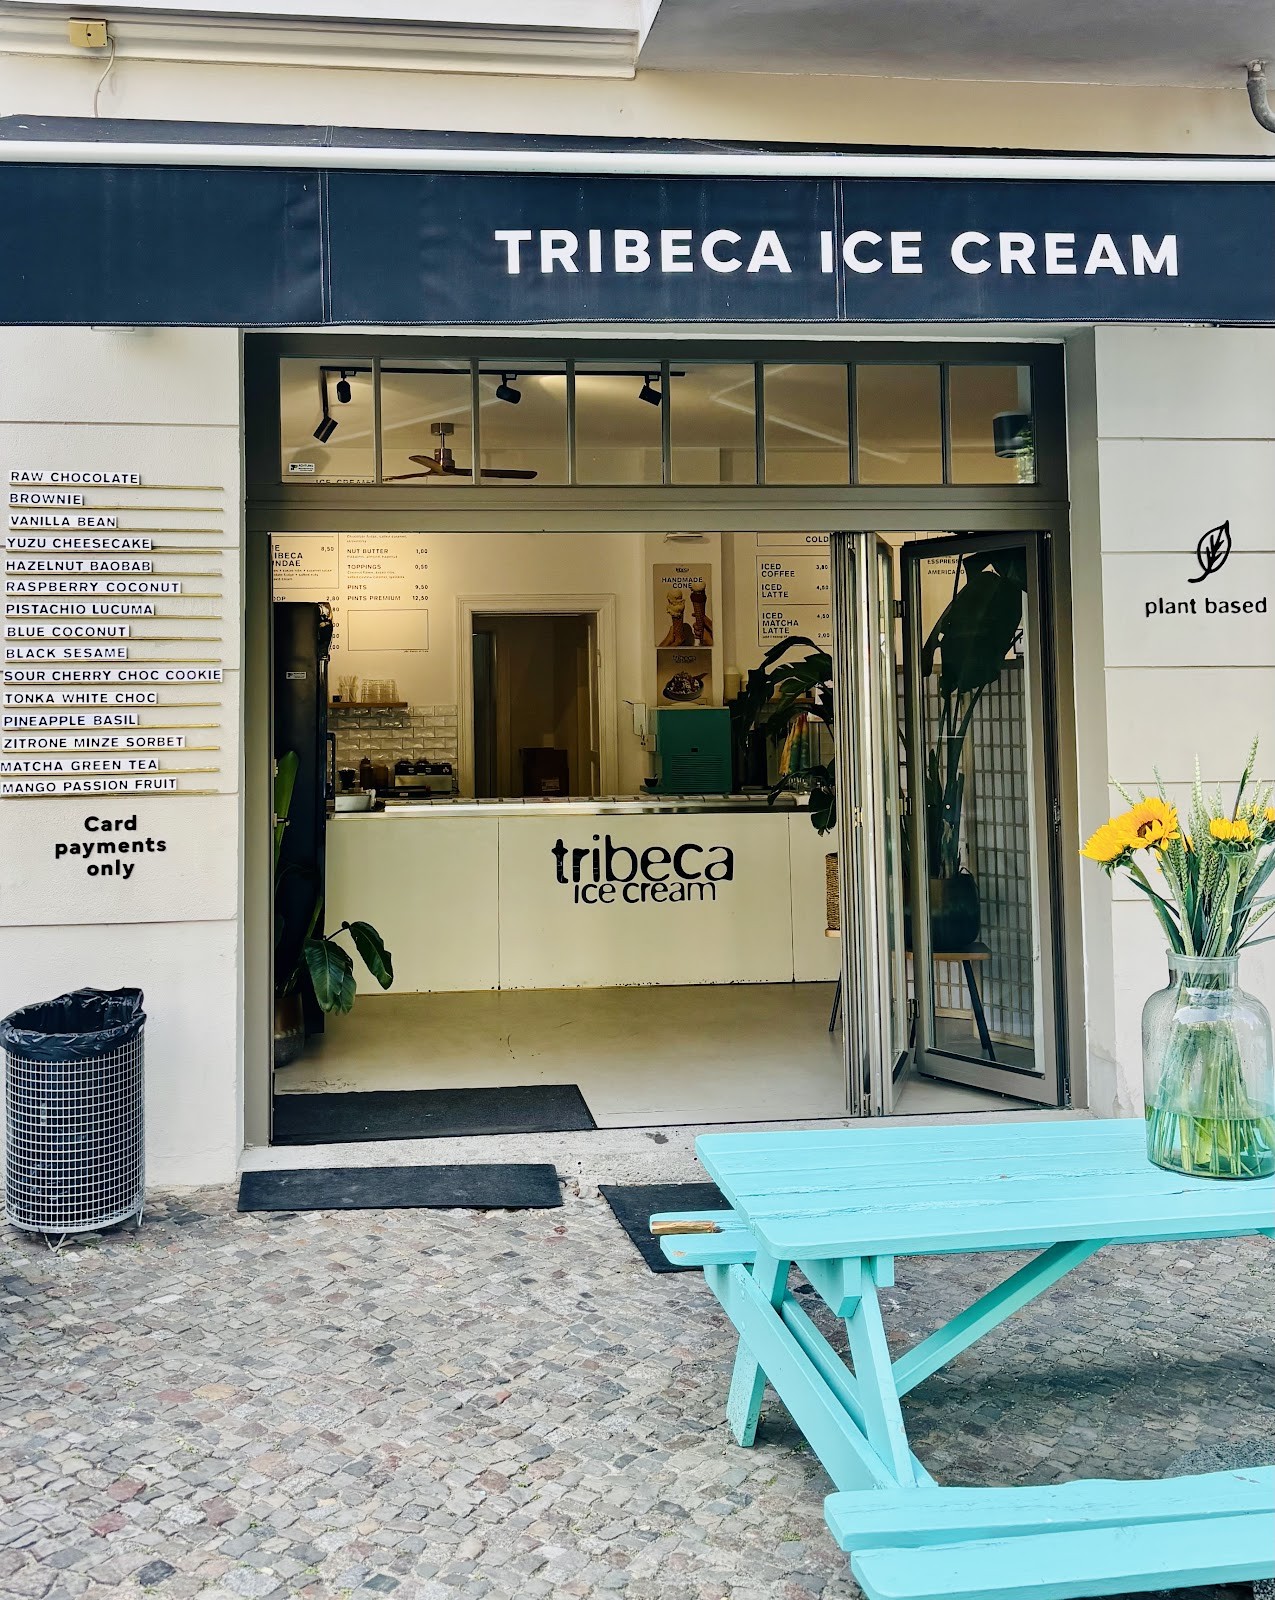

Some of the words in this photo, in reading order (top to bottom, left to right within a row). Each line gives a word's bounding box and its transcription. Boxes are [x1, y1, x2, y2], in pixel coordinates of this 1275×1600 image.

[495, 230, 792, 274] TRIBECA
[820, 229, 923, 275] ICE
[951, 232, 1178, 276] CREAM
[10, 471, 44, 481] RAW
[51, 472, 138, 484] CHOCOLATE
[10, 493, 81, 505] BROWNIE
[11, 516, 71, 526] VANILLA
[78, 517, 116, 527] BEAN
[7, 538, 46, 548] YUZU
[53, 538, 150, 549] CHEESECAKE
[805, 535, 829, 543] COLD
[6, 561, 84, 571] HAZELNUT
[90, 561, 151, 571] BAOBAB
[761, 570, 796, 578] COFFEE
[6, 582, 99, 593] RASPBERRY
[106, 582, 180, 593] COCONUT
[6, 604, 86, 615] PISTACHIO
[92, 605, 153, 615] LUCUMA
[1146, 598, 1196, 617] plant
[1206, 597, 1266, 613] based
[7, 627, 45, 638] BLUE
[52, 626, 126, 637] COCONUT
[6, 648, 56, 659] BLACK
[63, 647, 126, 658] SESAME
[4, 671, 46, 681] SOUR
[52, 671, 111, 681] CHERRY
[118, 670, 159, 680] CHOC
[165, 669, 221, 680] COOKIE
[5, 693, 55, 704] TONKA
[62, 693, 108, 703] WHITE
[115, 693, 156, 703] CHOC
[4, 715, 86, 727] PINEAPPLE
[93, 715, 136, 725] BASIL
[4, 738, 67, 749] ZITRONE
[74, 737, 119, 748] MINZE
[126, 736, 184, 747] SORBET
[0, 761, 63, 772] MATCHA
[71, 760, 121, 771] GREEN
[129, 759, 157, 770] TEA
[2, 783, 56, 793] MANGO
[63, 780, 128, 791] PASSION
[135, 778, 176, 790] FRUIT
[83, 814, 138, 832] Card
[55, 837, 167, 859] payments
[551, 834, 734, 883] tribeca
[86, 859, 136, 879] only
[574, 884, 616, 904] ice
[622, 882, 716, 904] cream
